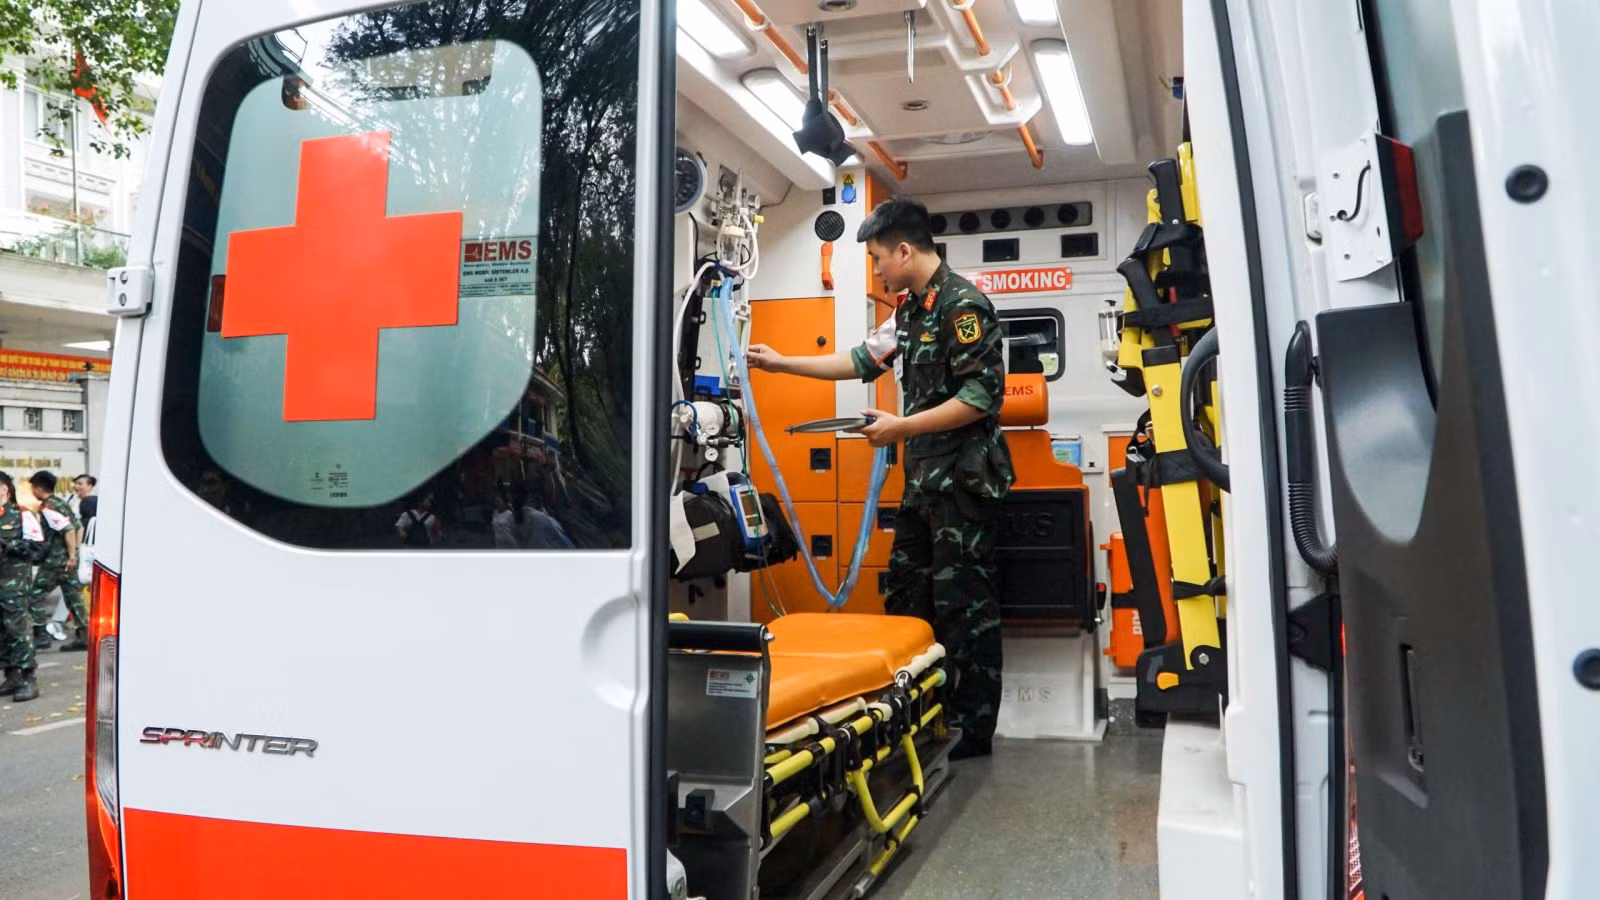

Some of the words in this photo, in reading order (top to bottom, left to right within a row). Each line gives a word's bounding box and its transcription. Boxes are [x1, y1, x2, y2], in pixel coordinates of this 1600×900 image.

[484, 240, 532, 261] EMS
[982, 271, 1066, 291] SMOKING
[1004, 385, 1034, 396] EMS
[140, 726, 319, 758] SPRINTER
